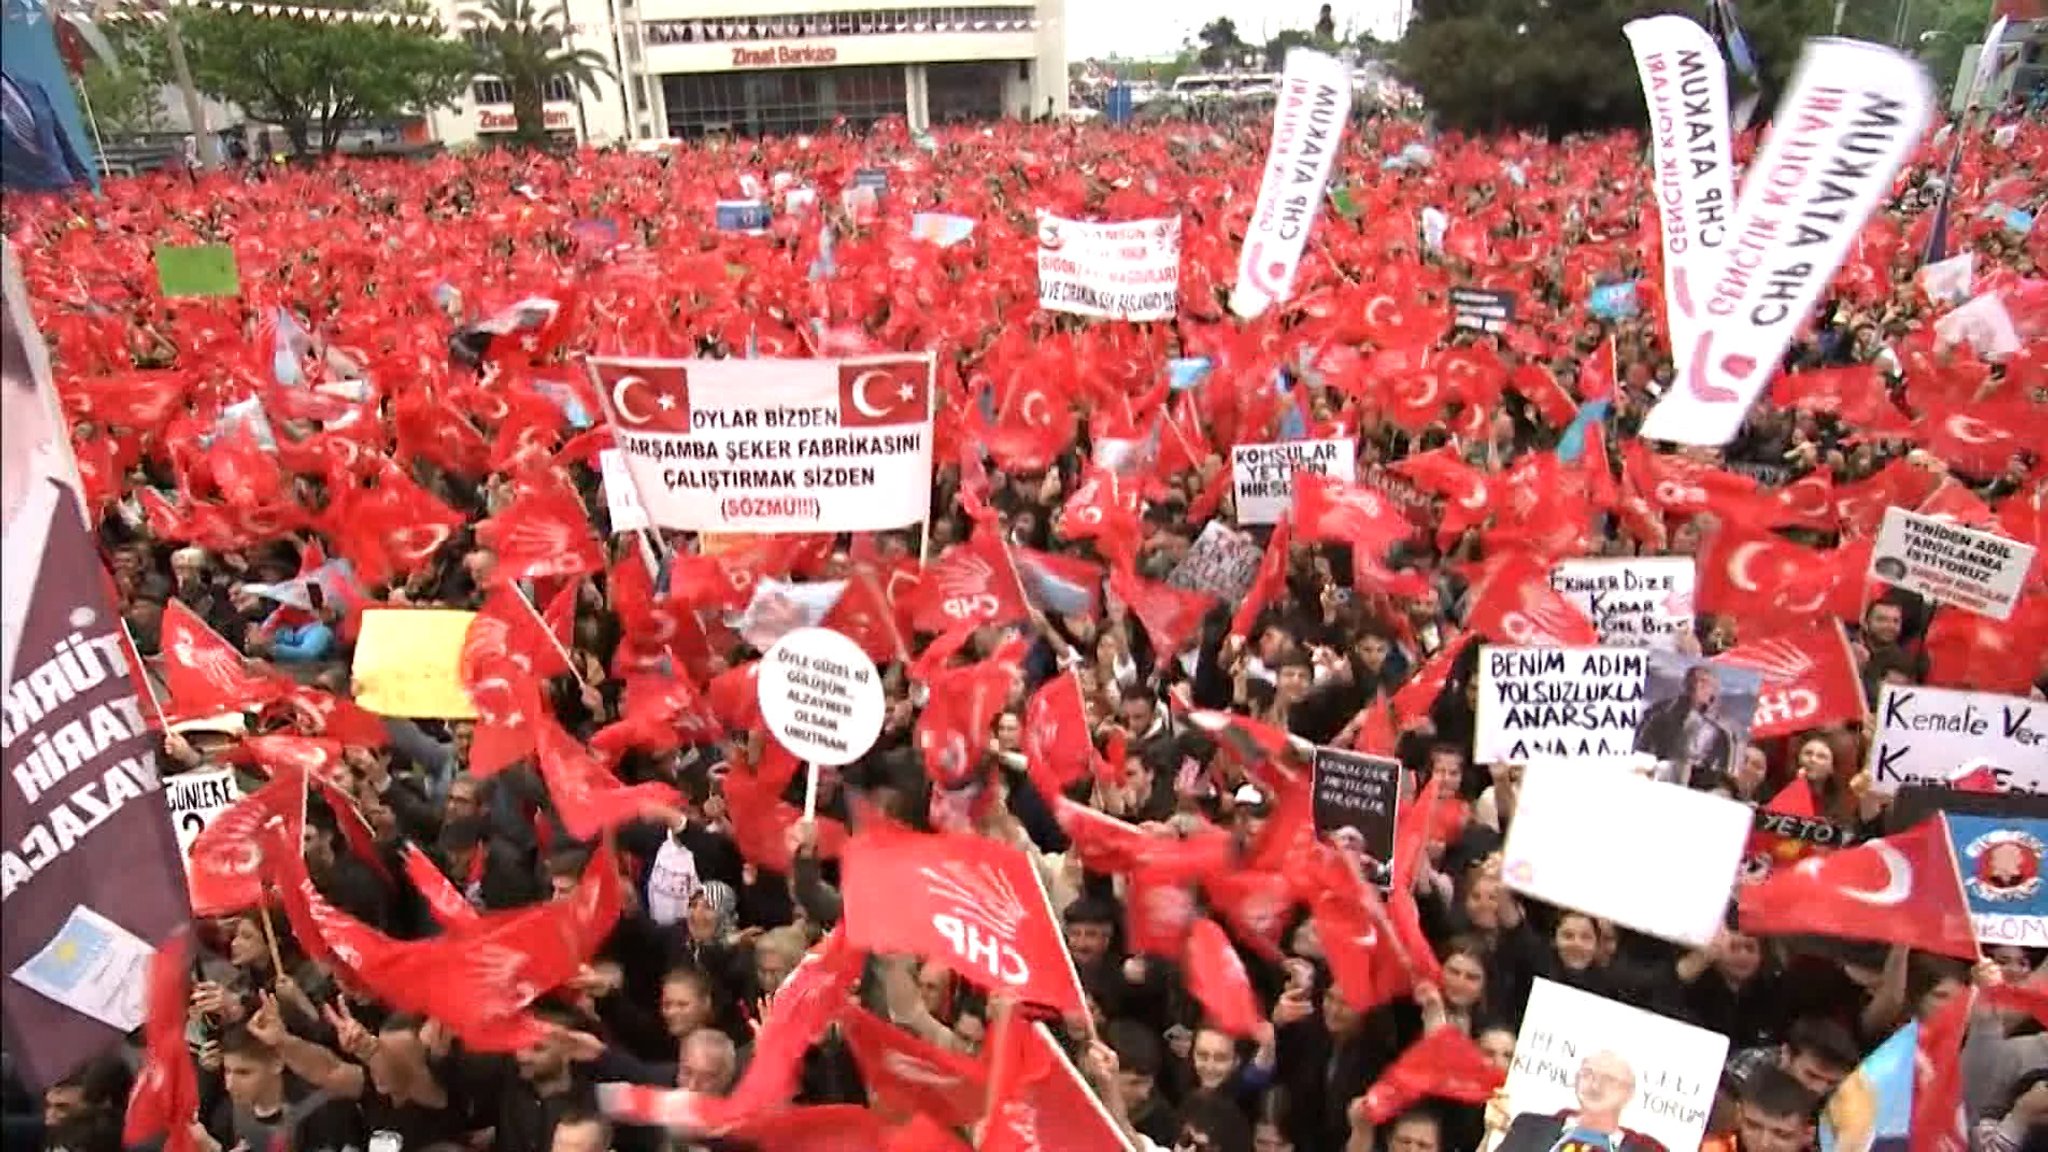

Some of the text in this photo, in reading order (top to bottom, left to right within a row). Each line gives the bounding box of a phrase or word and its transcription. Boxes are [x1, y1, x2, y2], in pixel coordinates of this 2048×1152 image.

[732, 46, 776, 65] Ziraat
[693, 404, 838, 429] OYLAR BİZDEN
[726, 438, 791, 465] ŞEKER
[799, 431, 920, 458] FABRİKASINI
[664, 465, 875, 491] ÇALIŞTIRMAK SİZDEN
[1491, 650, 1565, 678] BENİM
[1495, 681, 1643, 704] YOLSUZLUKLA
[1503, 704, 1636, 730] ANARSAN
